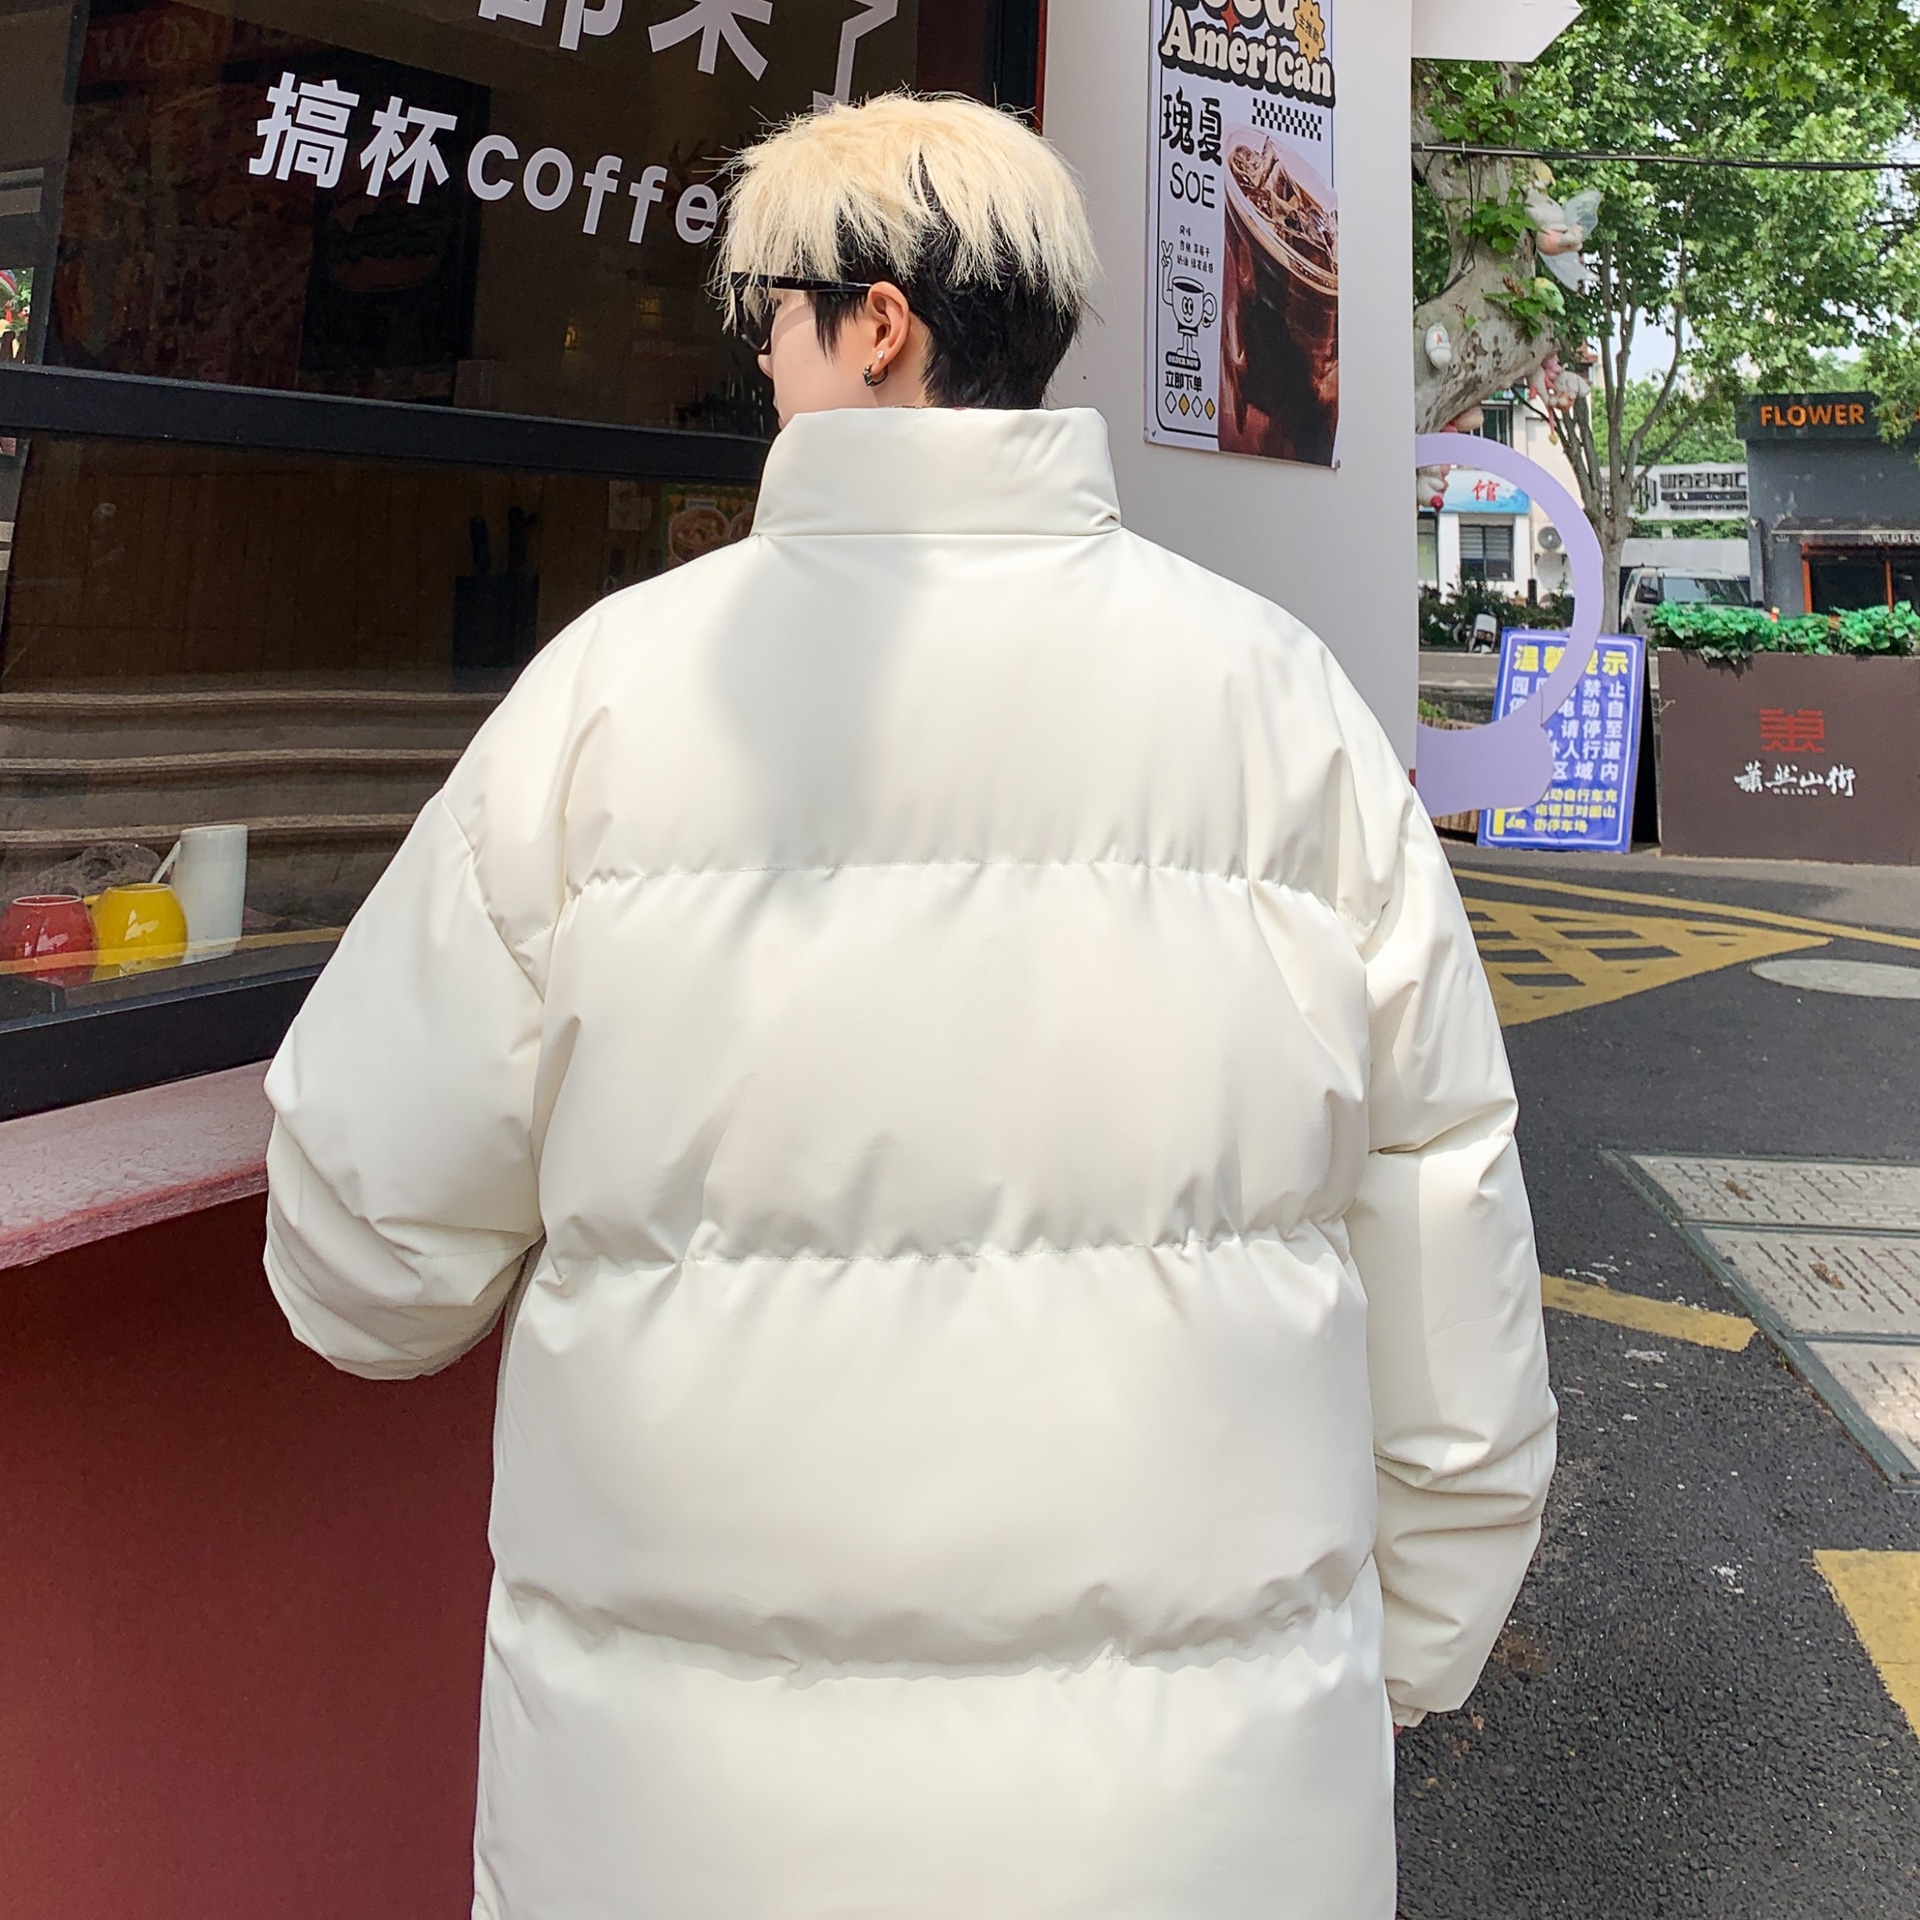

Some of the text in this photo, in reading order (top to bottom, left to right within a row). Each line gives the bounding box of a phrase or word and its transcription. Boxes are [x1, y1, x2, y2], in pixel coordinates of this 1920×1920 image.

[1160, 5, 1333, 98] American
[1161, 86, 1223, 167] 瑰夏
[1170, 162, 1215, 209] SOE
[1165, 370, 1203, 392] 立即下单
[1760, 403, 1865, 428] FLOWER
[1472, 479, 1500, 502] 馆
